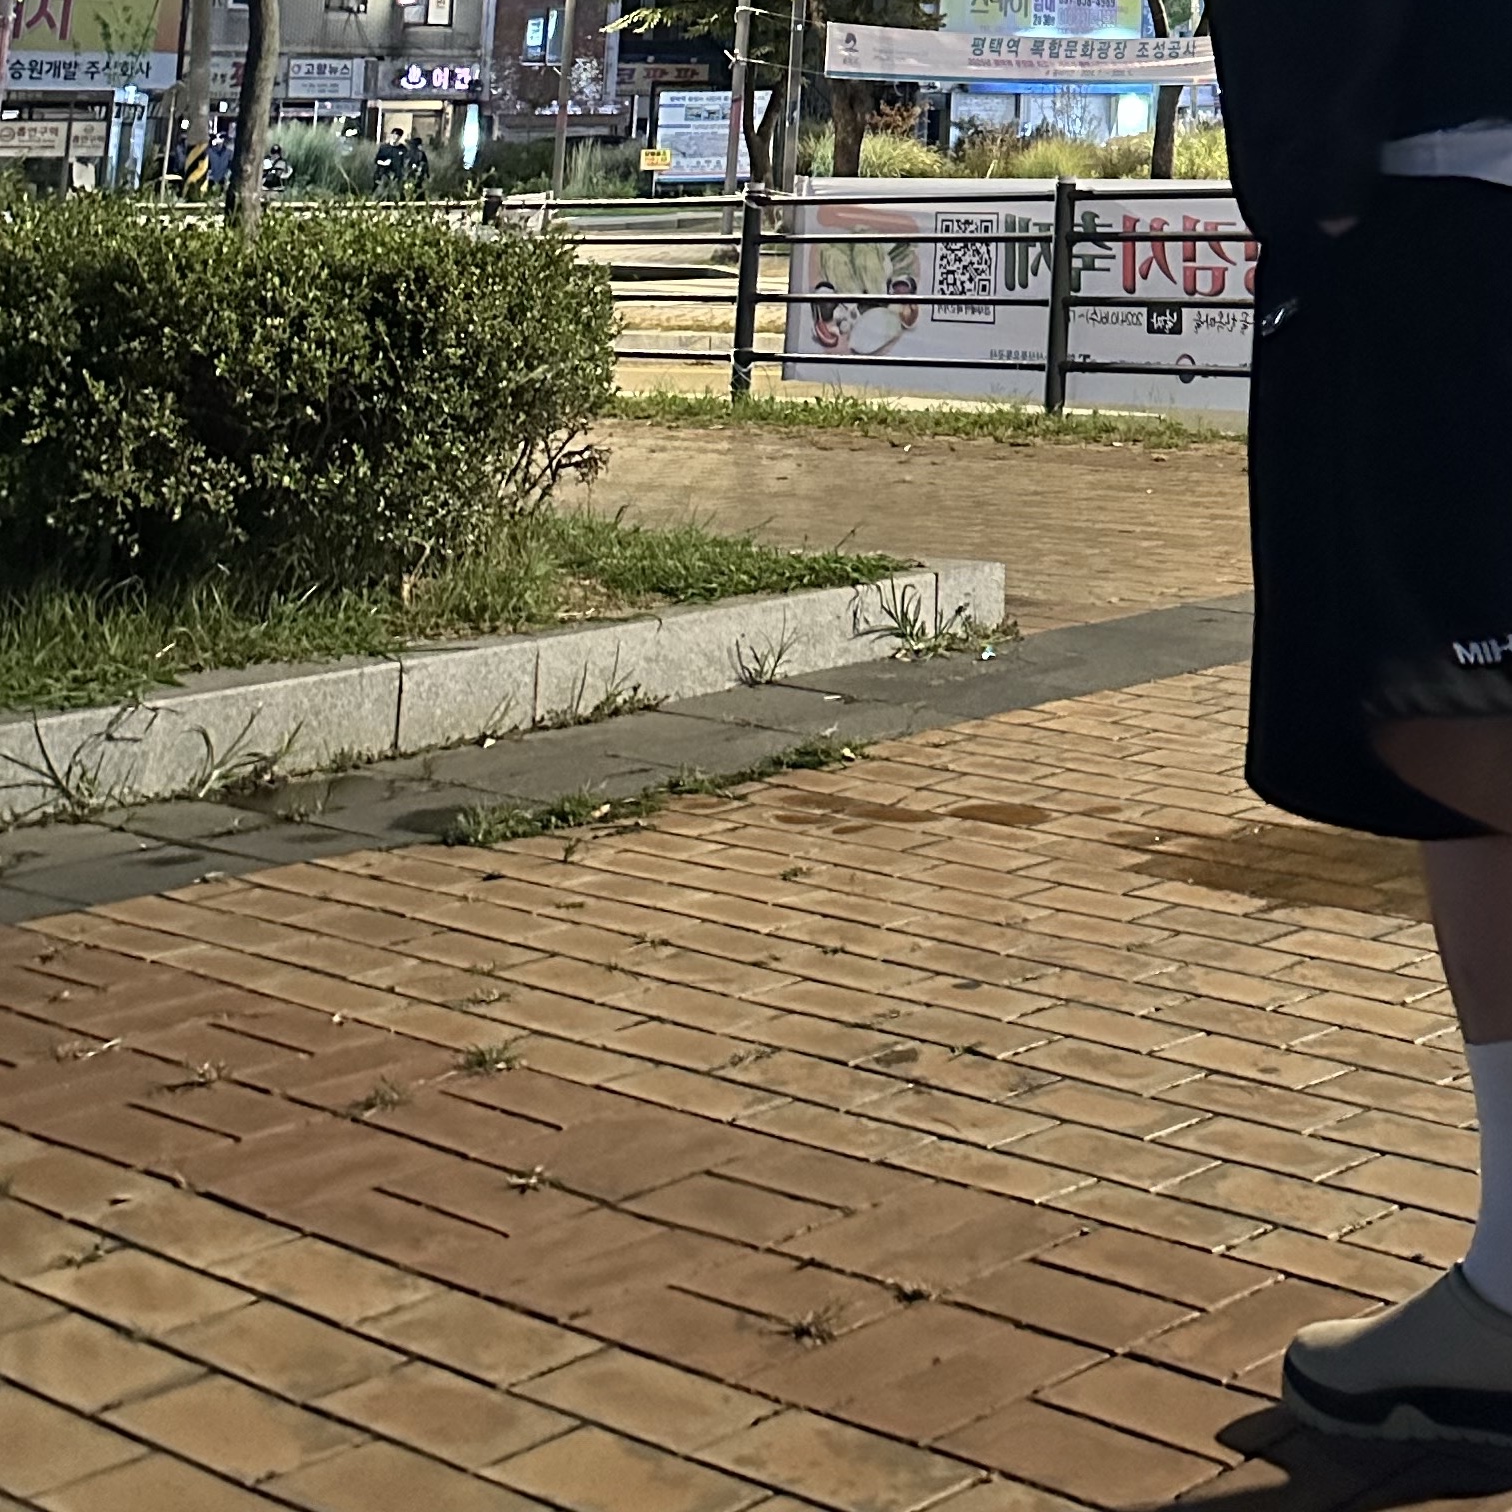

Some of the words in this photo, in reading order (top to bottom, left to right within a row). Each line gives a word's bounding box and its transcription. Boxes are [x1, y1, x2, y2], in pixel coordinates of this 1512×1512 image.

[971, 37, 1021, 57] 평택역
[1030, 39, 1128, 61] 복합문화광장
[1136, 40, 1197, 59] 조성공사
